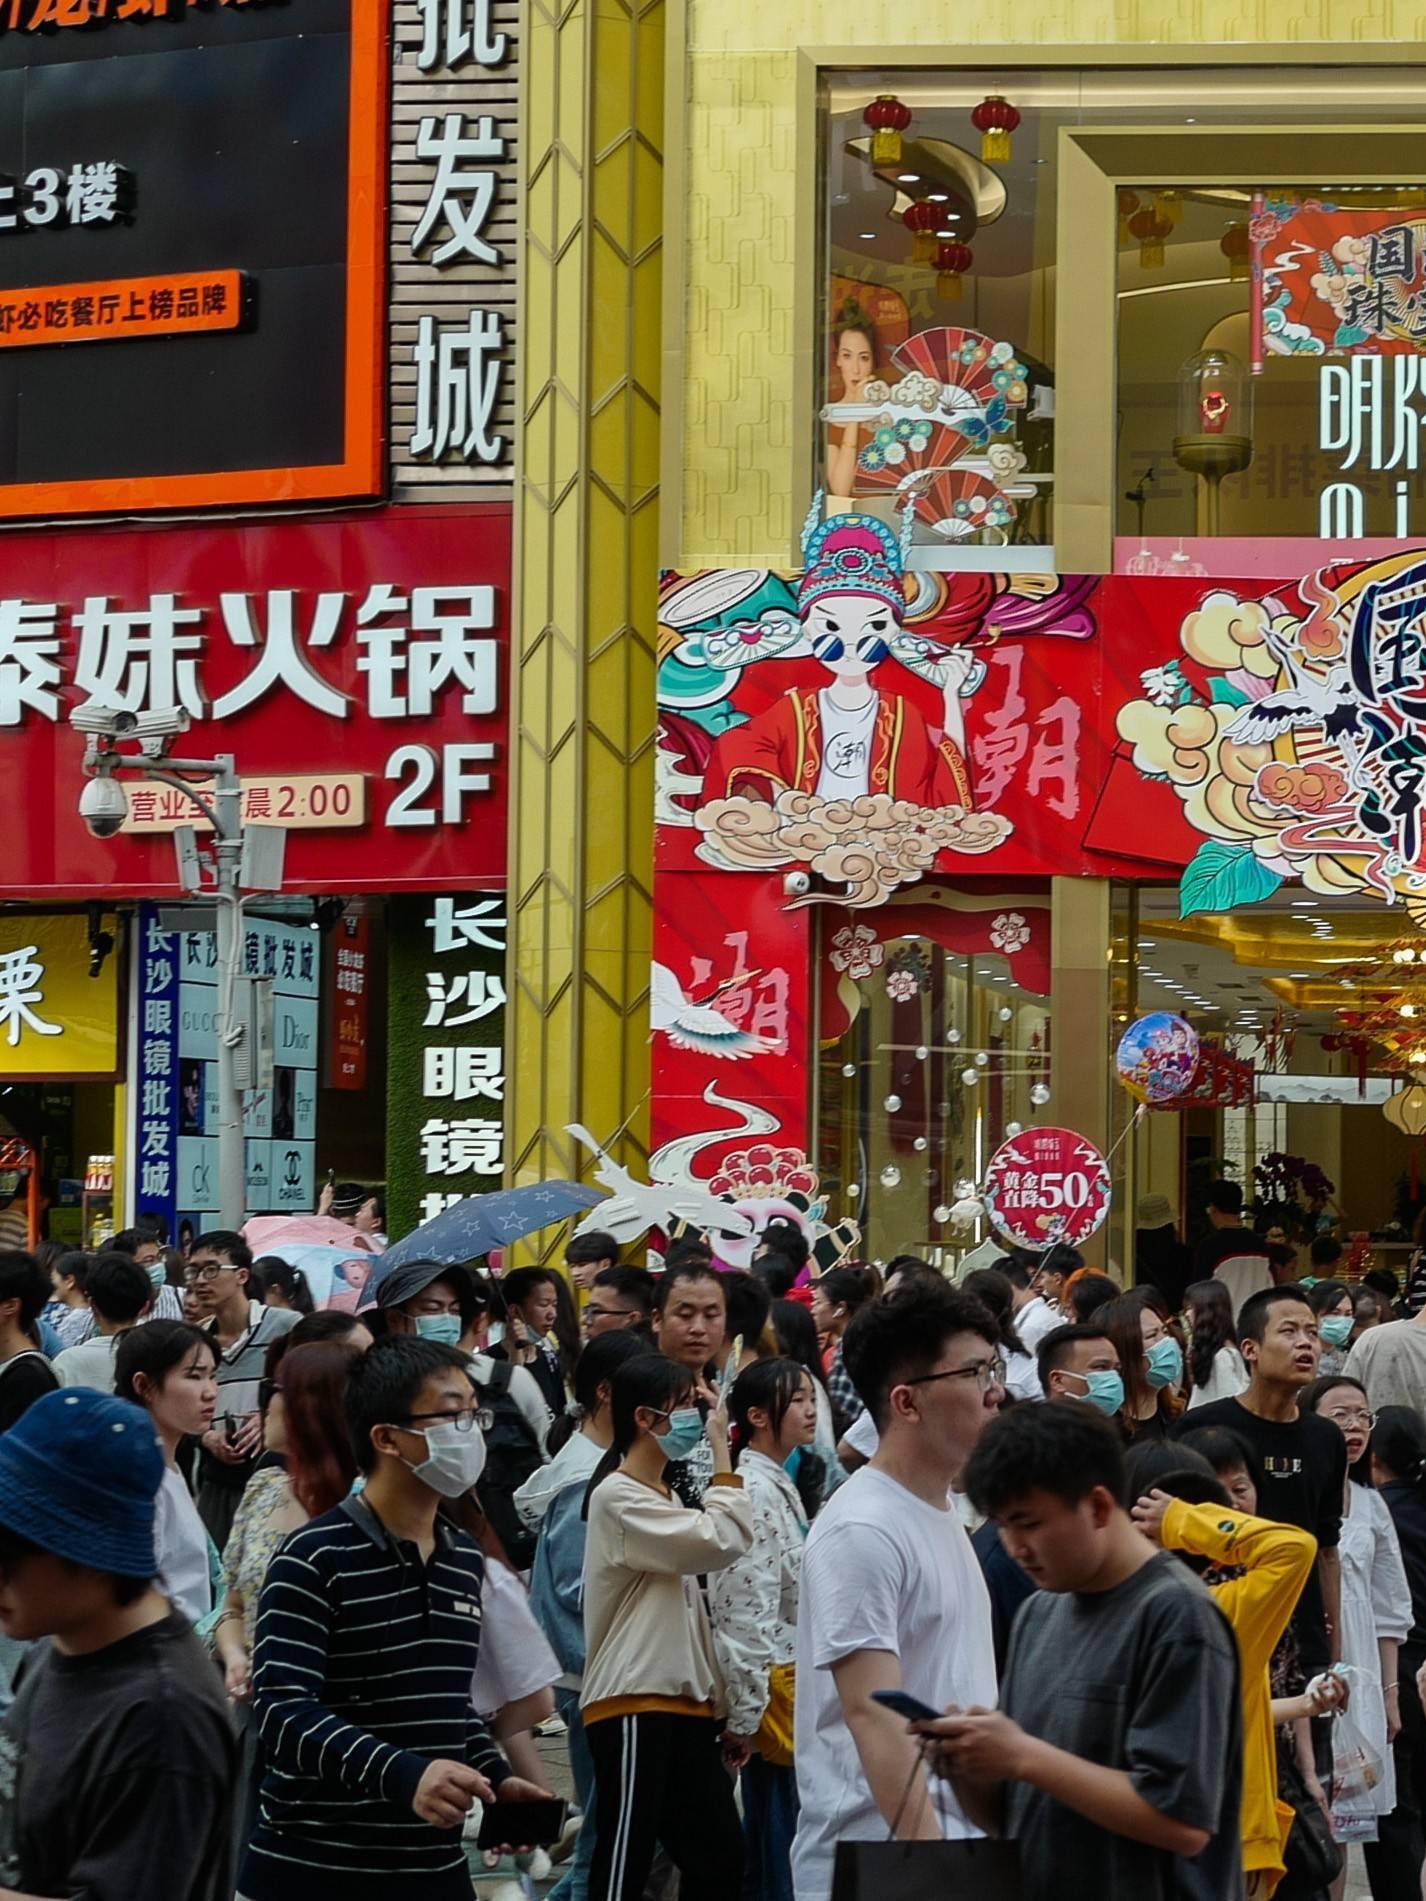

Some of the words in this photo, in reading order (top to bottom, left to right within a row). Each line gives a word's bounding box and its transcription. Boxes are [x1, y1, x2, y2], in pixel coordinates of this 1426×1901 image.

[131, 783, 351, 824] 营业至晨2:00
[385, 743, 495, 827] 2F
[182, 1010, 223, 1034] GUCC
[282, 1014, 310, 1049] Dior
[141, 917, 174, 1198] 长沙眼镜批发城
[1039, 1171, 1089, 1209] 50
